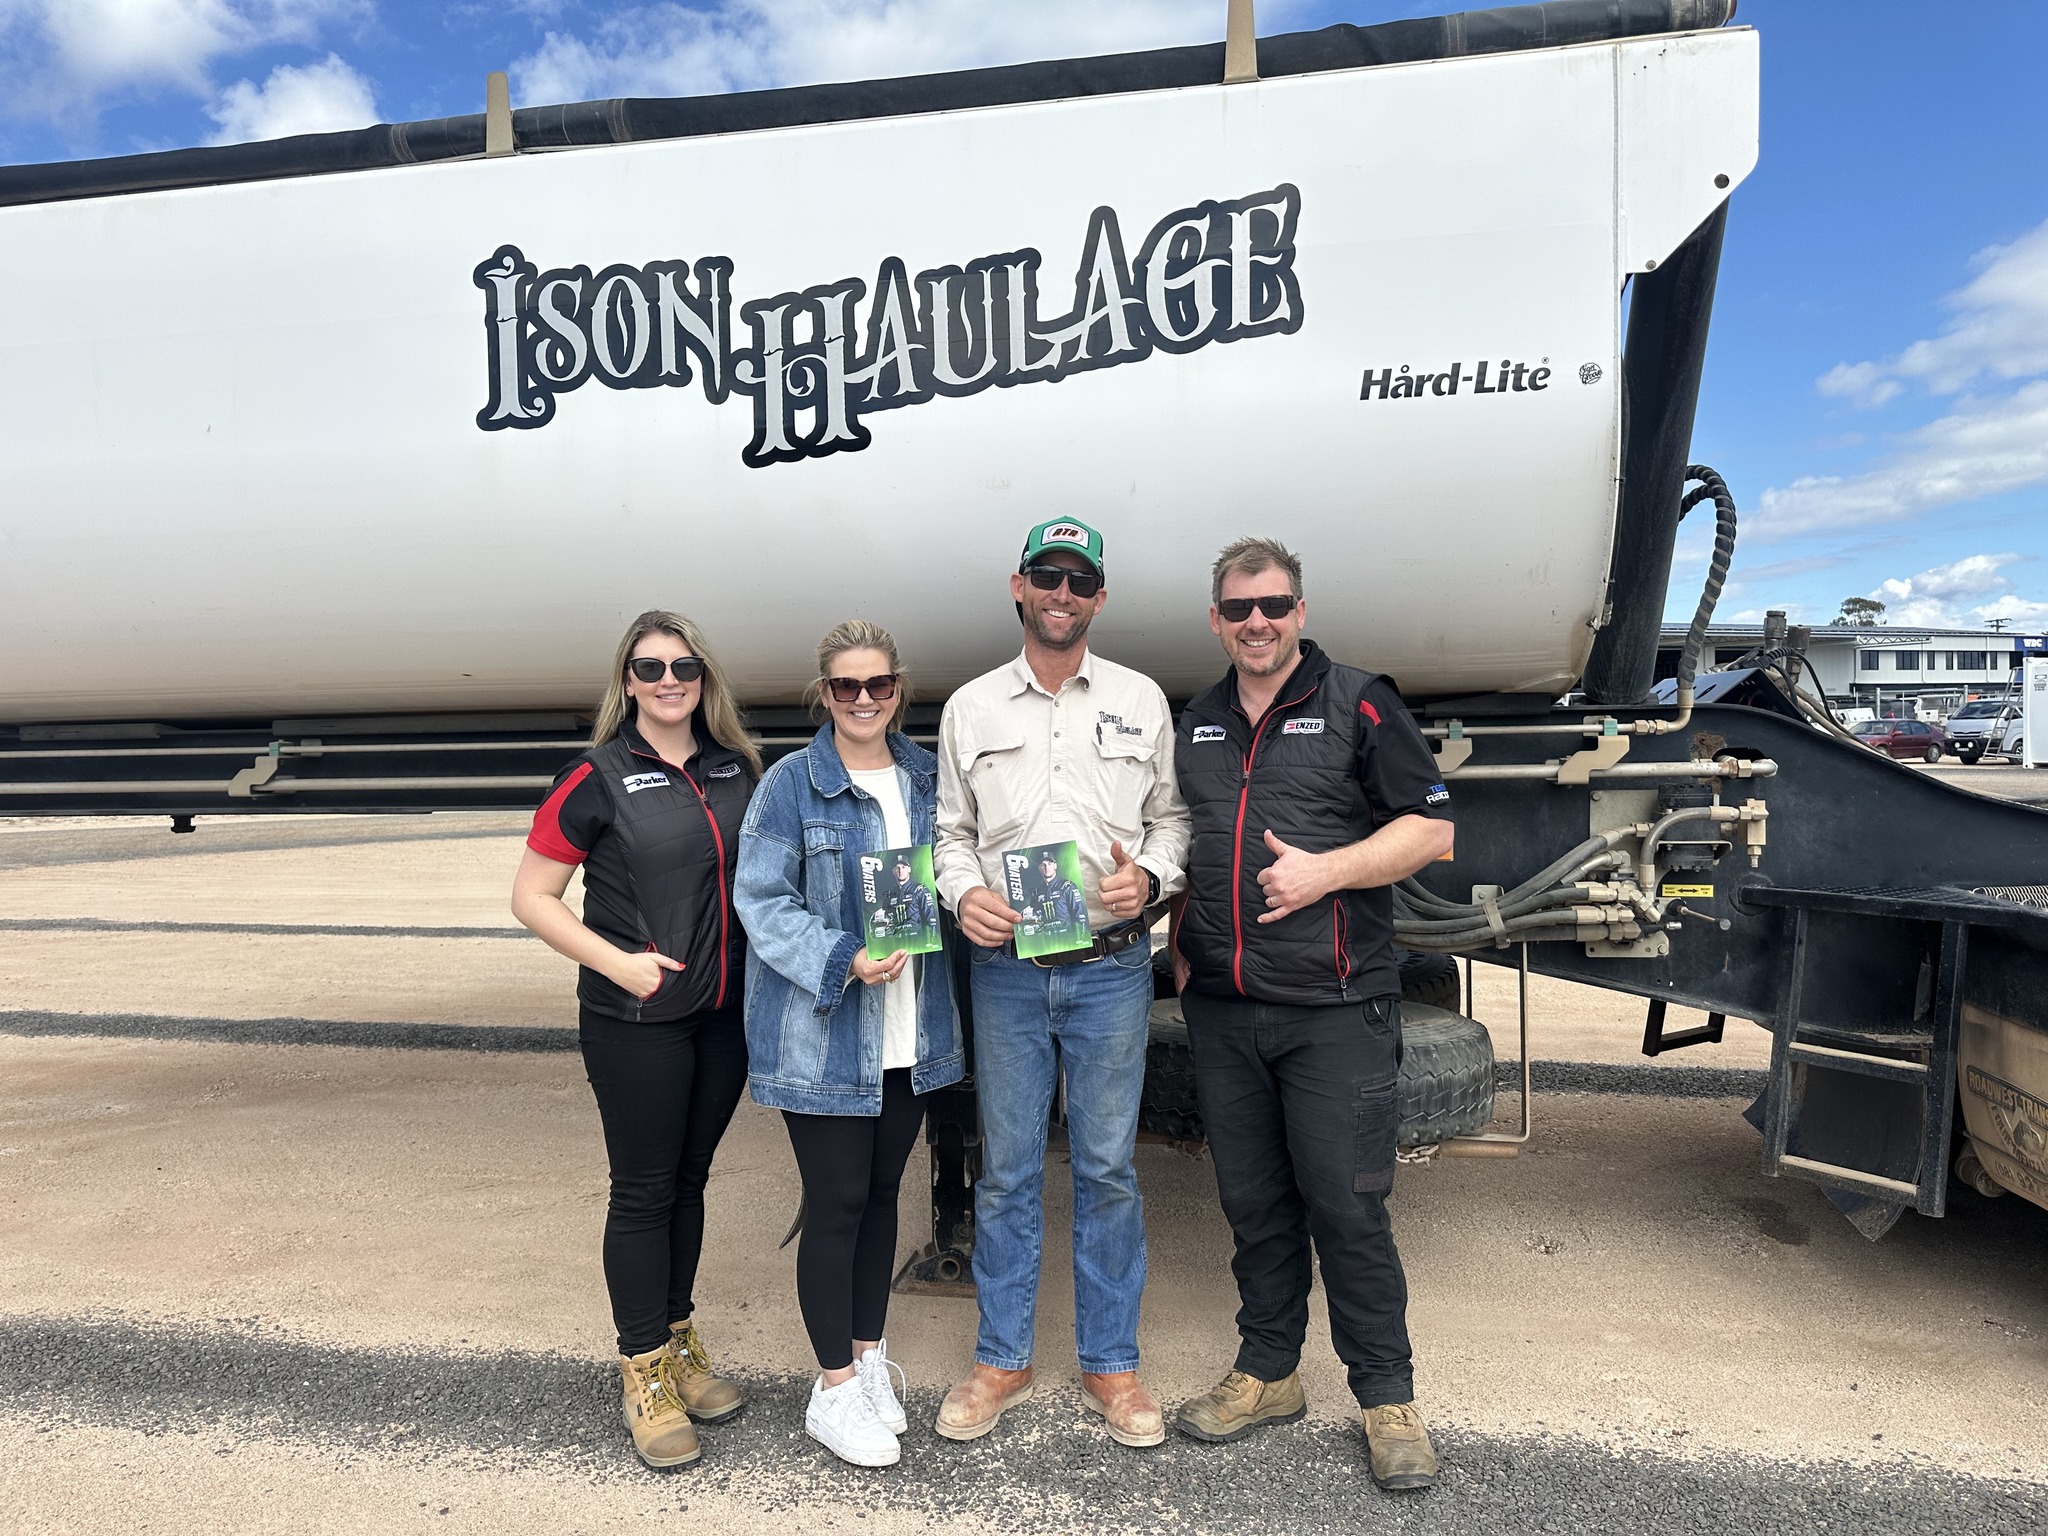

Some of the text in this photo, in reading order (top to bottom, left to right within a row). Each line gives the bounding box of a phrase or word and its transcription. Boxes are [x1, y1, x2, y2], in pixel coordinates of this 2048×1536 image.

[730, 183, 1304, 468] HAULAGE
[1198, 729, 1225, 738] Parker
[635, 776, 667, 787] Parker
